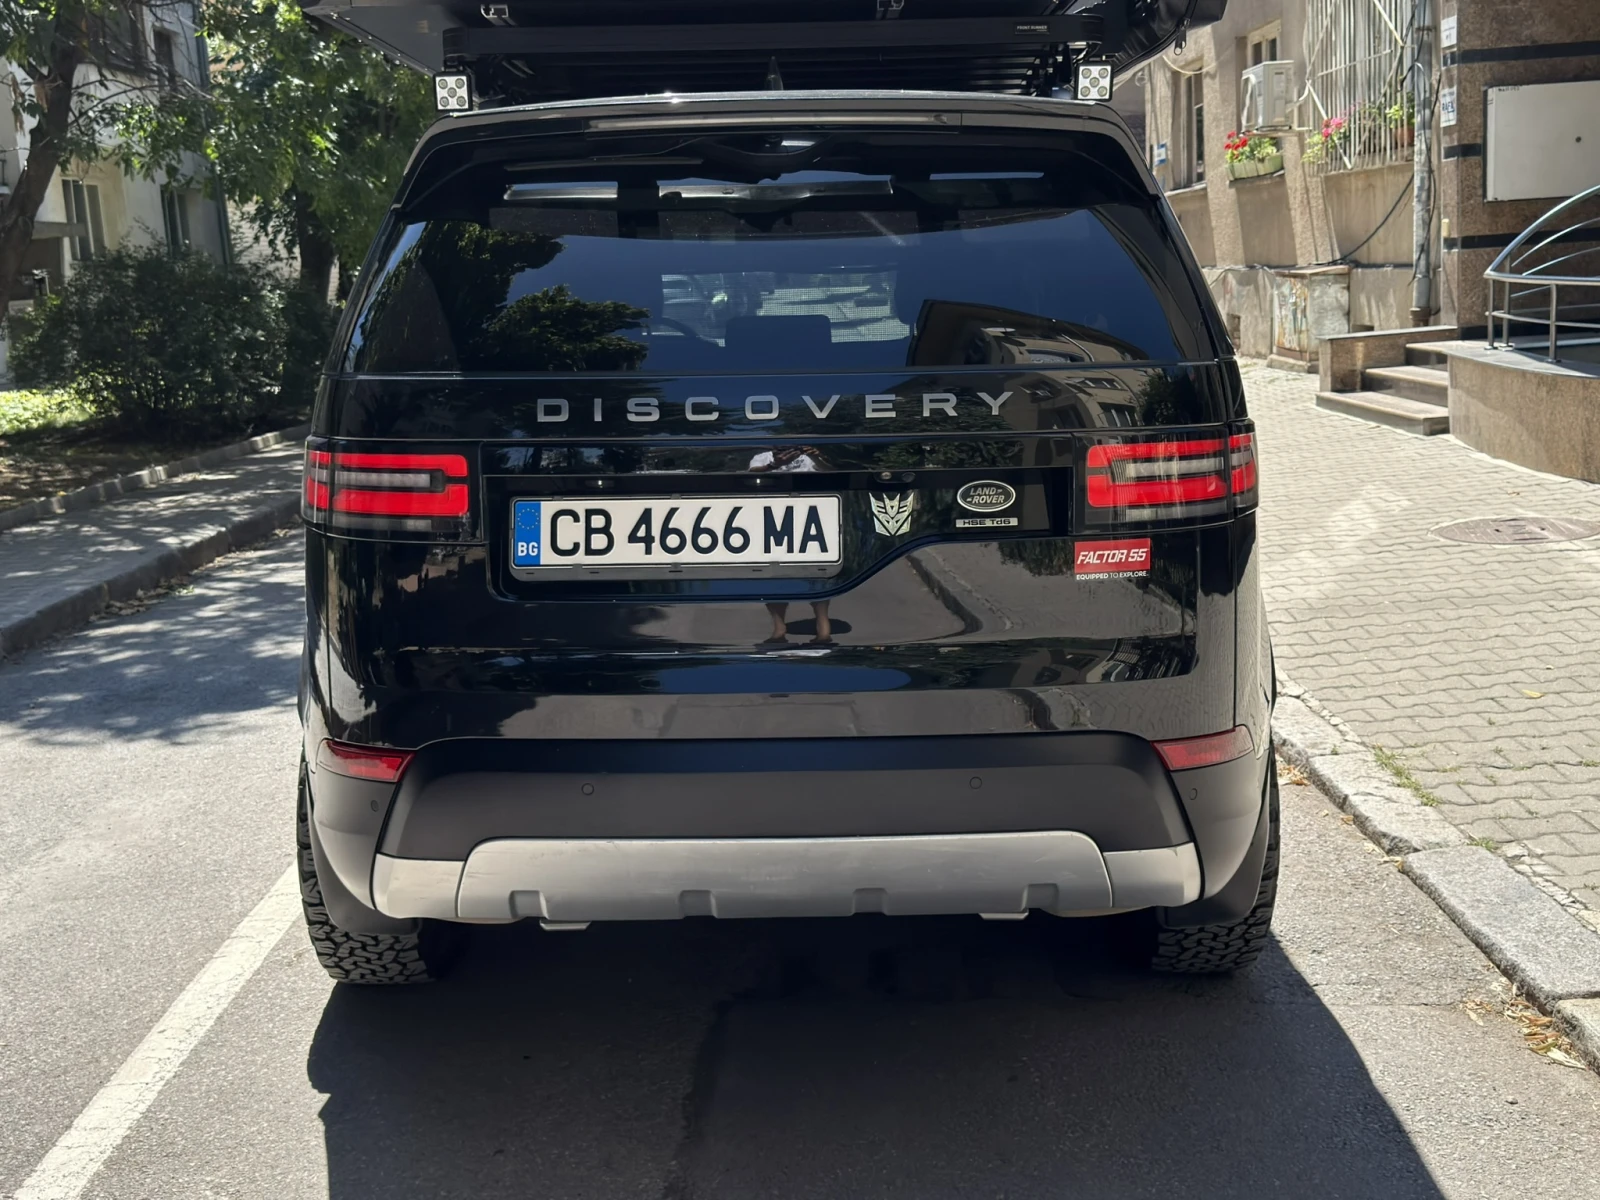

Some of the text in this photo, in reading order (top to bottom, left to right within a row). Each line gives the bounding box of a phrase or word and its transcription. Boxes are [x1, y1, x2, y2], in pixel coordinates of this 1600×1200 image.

[537, 391, 1014, 422] DISCOVERY
[989, 518, 1011, 526] Td6
[550, 505, 829, 557] CB 4666 MA
[517, 542, 538, 556] BG
[1076, 548, 1149, 565] FACTOR 55
